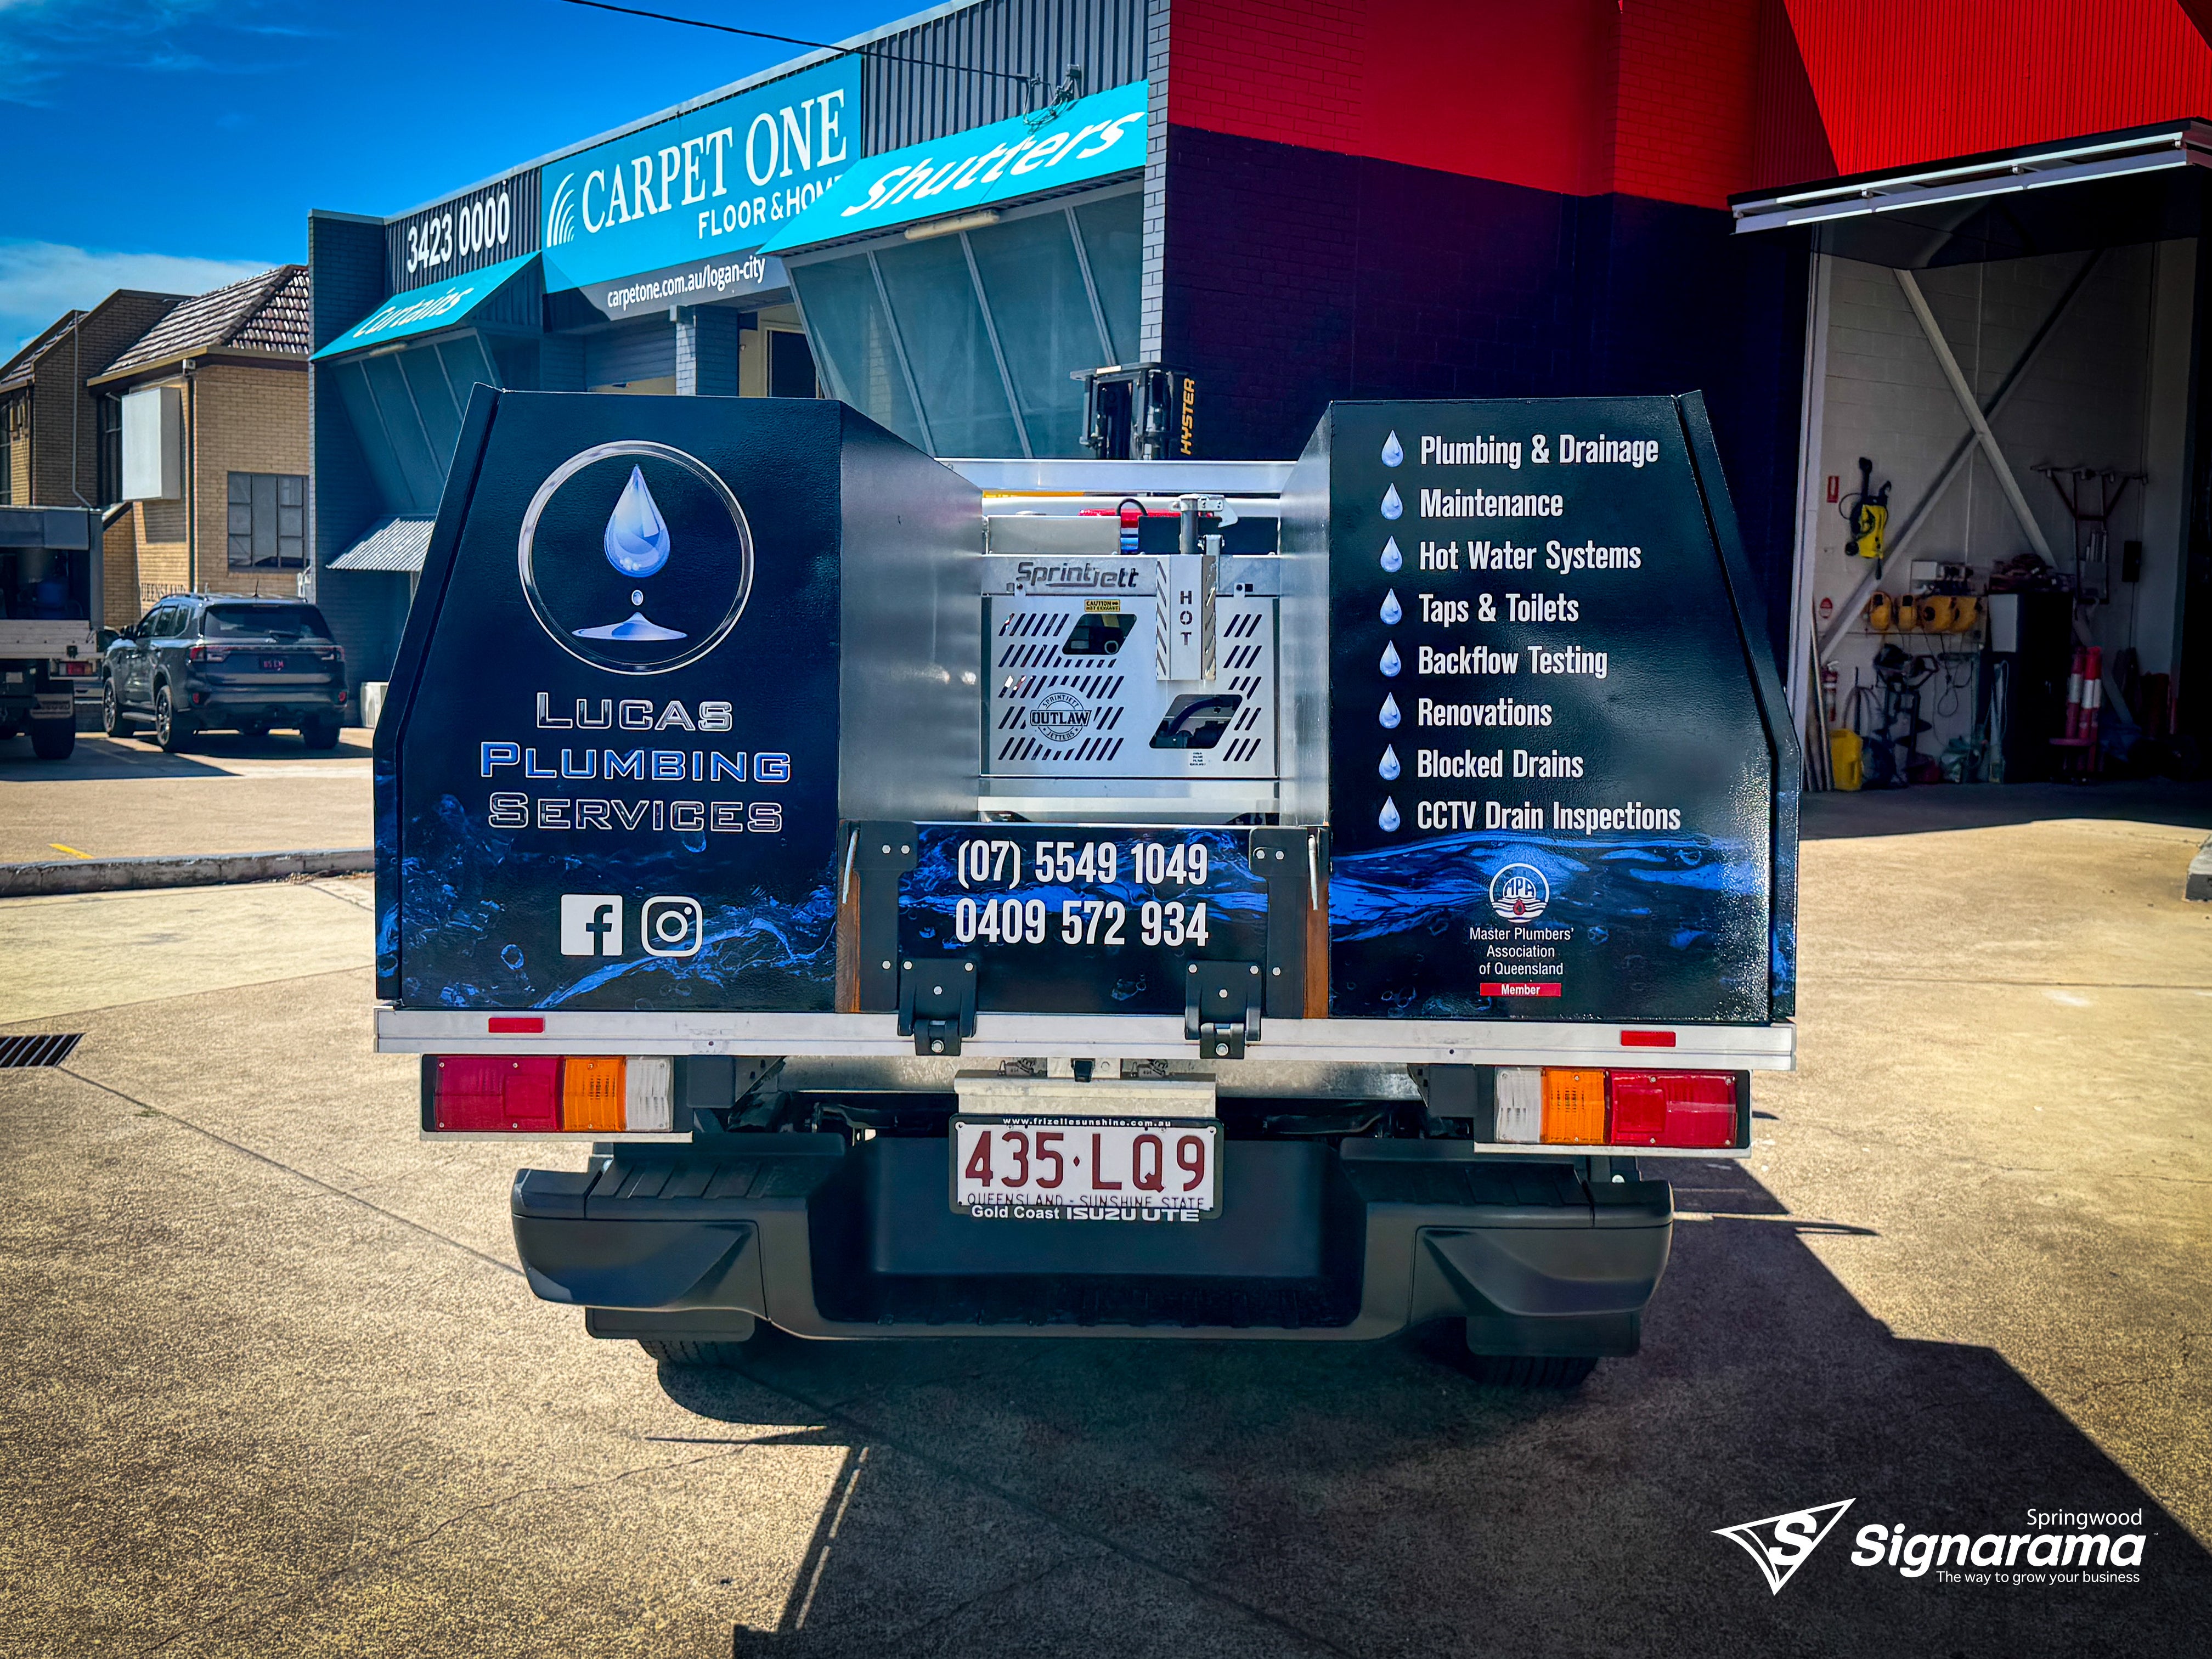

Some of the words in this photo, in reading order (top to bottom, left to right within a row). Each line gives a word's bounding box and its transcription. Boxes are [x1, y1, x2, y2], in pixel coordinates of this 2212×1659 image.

[582, 126, 733, 233] CARPET
[746, 88, 847, 187] ONE
[840, 111, 1146, 217] Shutters
[407, 213, 453, 273] 3423
[459, 193, 510, 256] 0000
[698, 196, 766, 239] FLOOR
[607, 256, 765, 311] carpetone.com.au/logan-city
[1180, 377, 1195, 455] HYSTER
[1420, 435, 1522, 469] Plumbing
[1531, 435, 1549, 463] &
[1559, 434, 1658, 468] Drainage
[1420, 488, 1564, 517] Maintenance
[1419, 541, 1459, 570] Hot
[1468, 541, 1537, 569] Water
[1545, 540, 1641, 574] Systems
[1017, 562, 1139, 587] Sprintjett
[1180, 590, 1193, 646] HOT
[1418, 593, 1469, 627] Taps
[1478, 593, 1497, 622] &
[1505, 592, 1579, 622] Toilets
[1418, 645, 1519, 675] Backflow
[1527, 645, 1607, 679] Testing
[1032, 712, 1089, 725] OUTLAW
[1418, 698, 1553, 726] Renovations
[1418, 749, 1503, 778] Blocked
[1513, 749, 1584, 778] Drains
[1417, 801, 1476, 830] CCTV
[1485, 801, 1543, 830] Drain
[1553, 801, 1681, 834] Inspections
[958, 839, 1020, 889] (07)
[1035, 842, 1117, 883] 5549
[1131, 843, 1207, 884] 1049
[956, 898, 1045, 944] 0409
[1062, 900, 1125, 945] 572
[1141, 901, 1209, 946] 934
[1470, 927, 1510, 940] Master
[1487, 945, 1555, 957] Association
[1479, 962, 1491, 975] of
[1494, 962, 1563, 975] Queensland
[1501, 984, 1541, 995] Member
[1003, 1117, 1171, 1128] www.frizellesunshine.com.au
[967, 1193, 1063, 1206] QUEENSLAND
[972, 1205, 1008, 1218] Gold
[1013, 1205, 1059, 1220] Coast
[1066, 1207, 1139, 1221] ISUZU
[1142, 1209, 1200, 1222] UTE
